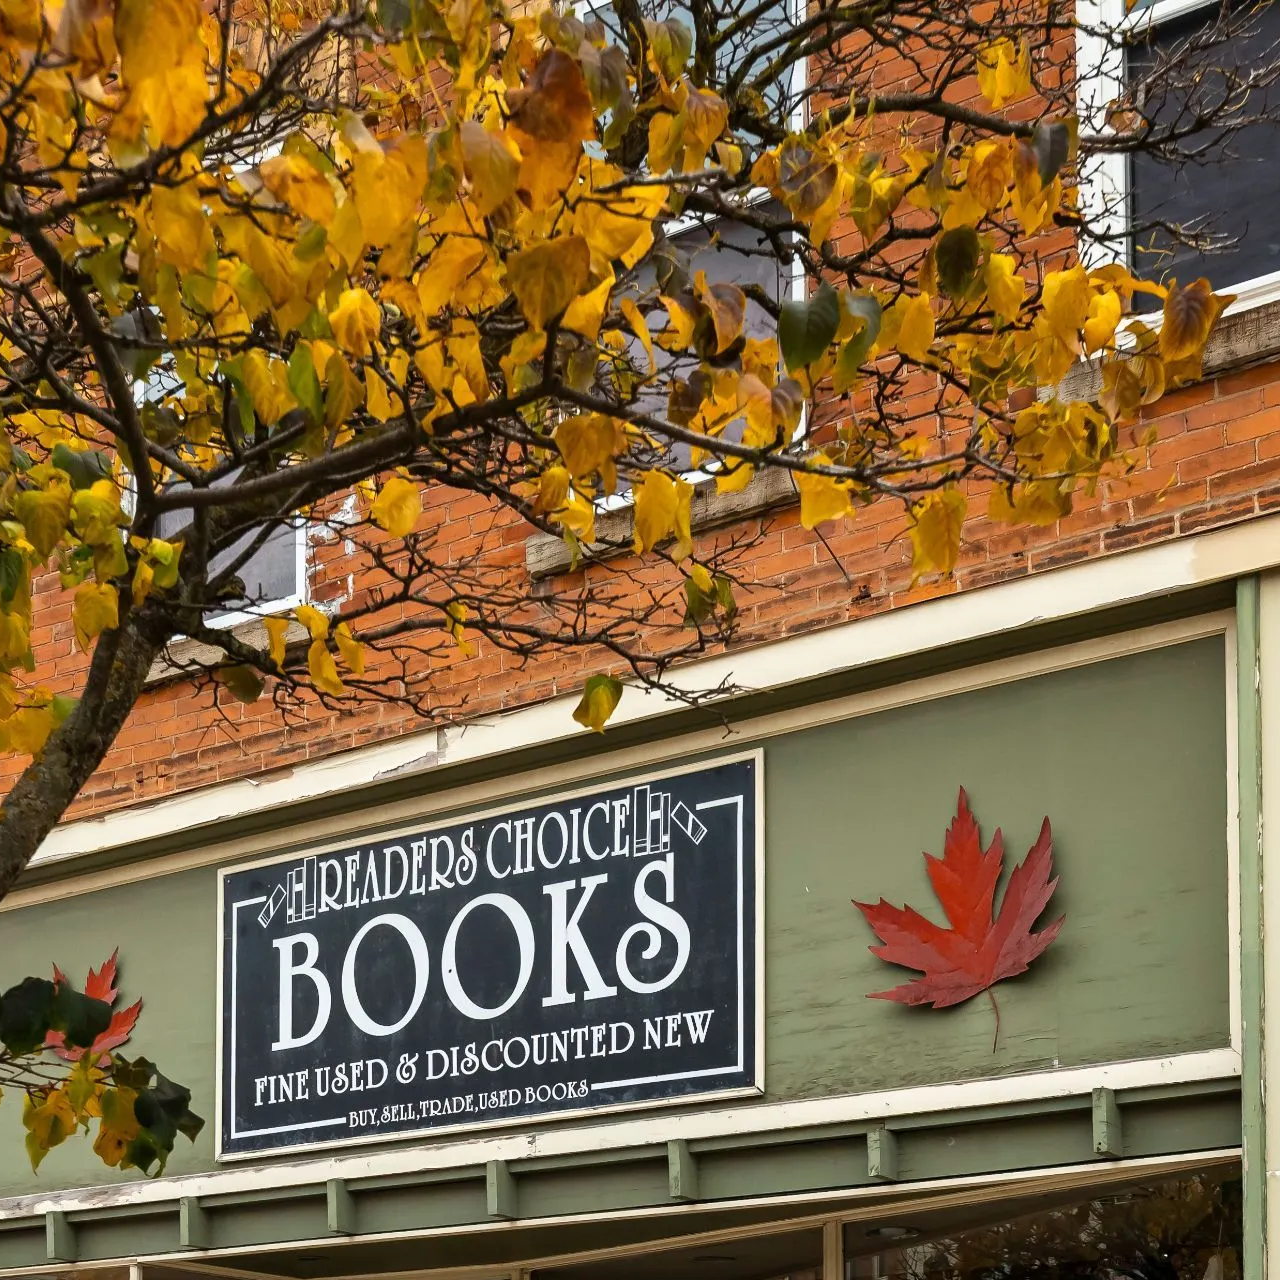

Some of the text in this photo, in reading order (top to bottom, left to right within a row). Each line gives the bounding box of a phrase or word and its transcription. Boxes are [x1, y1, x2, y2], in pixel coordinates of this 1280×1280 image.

[318, 794, 630, 913] READERS CHOICE
[271, 853, 692, 1052] BOOKS
[253, 1010, 715, 1106] FINE USED & DISCOUNTED NEW
[525, 1079, 589, 1104] BOOKS
